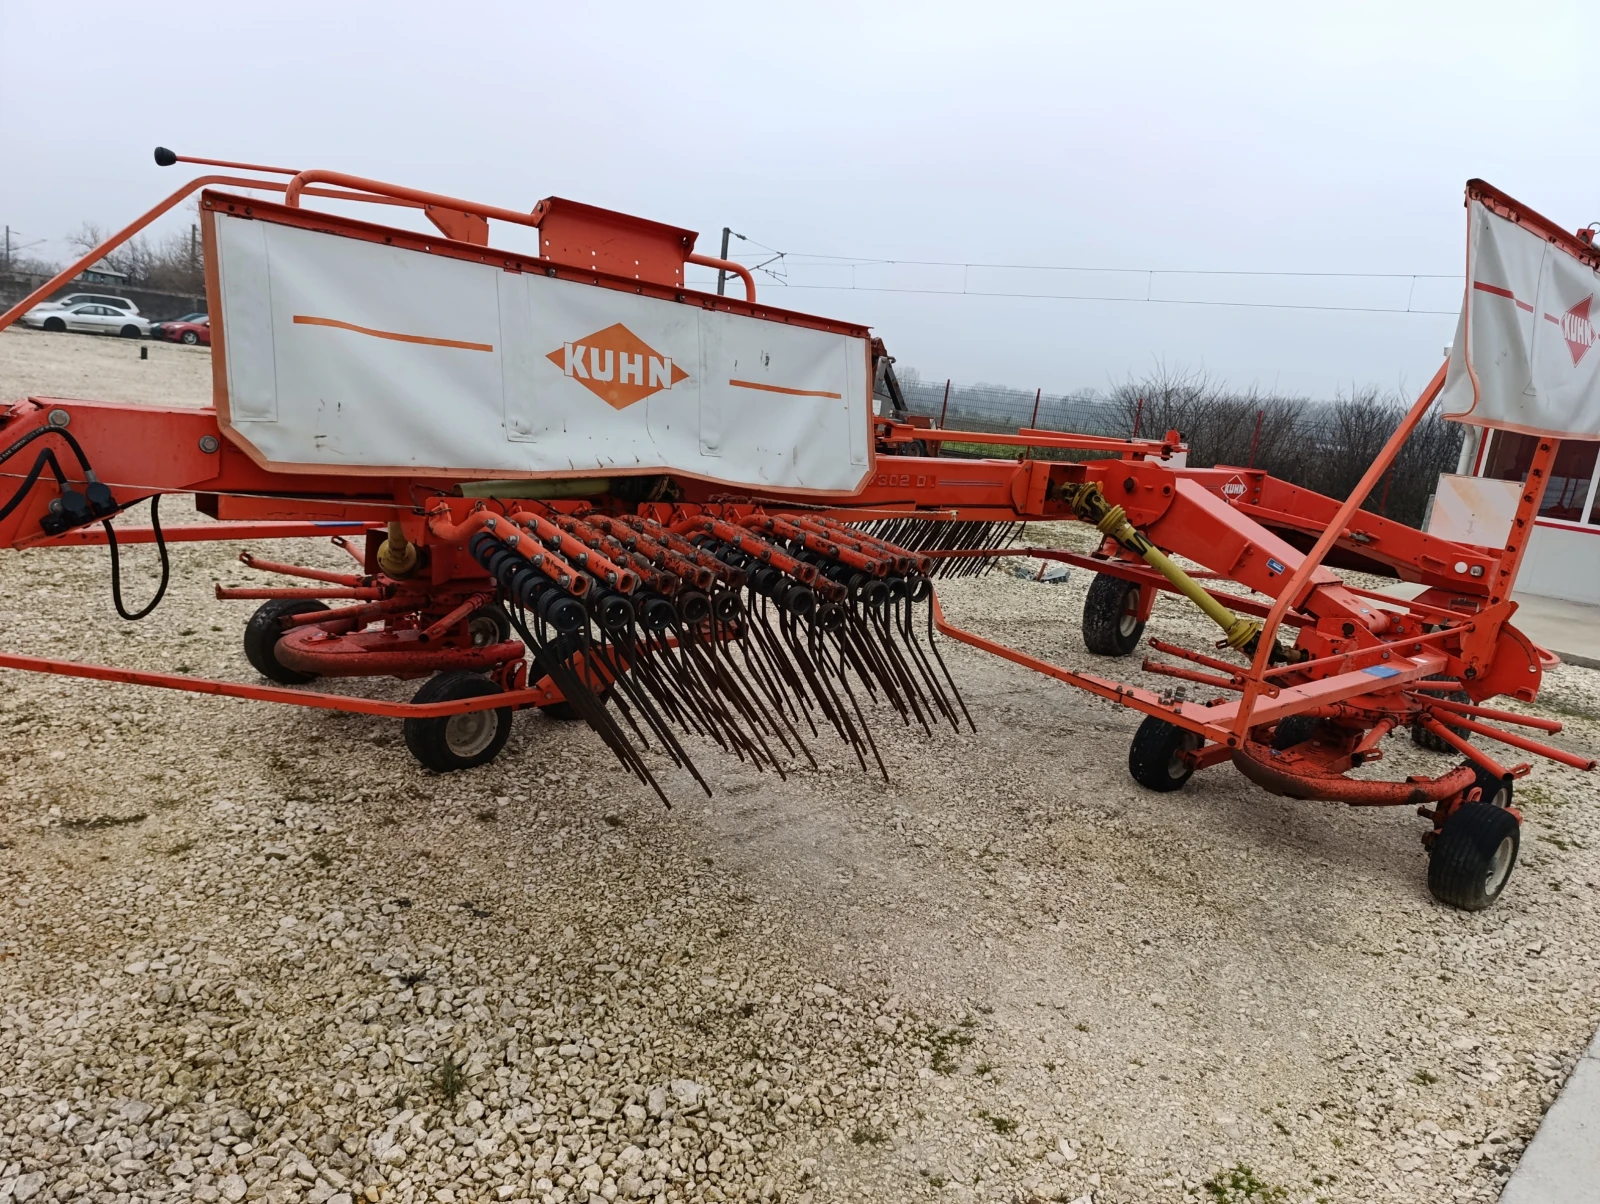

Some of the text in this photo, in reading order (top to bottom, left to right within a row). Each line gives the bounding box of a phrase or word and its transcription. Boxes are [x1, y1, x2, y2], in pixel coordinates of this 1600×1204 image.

[1564, 311, 1592, 348] KUHN
[563, 342, 672, 390] KUHN
[1224, 483, 1244, 495] KUHN
